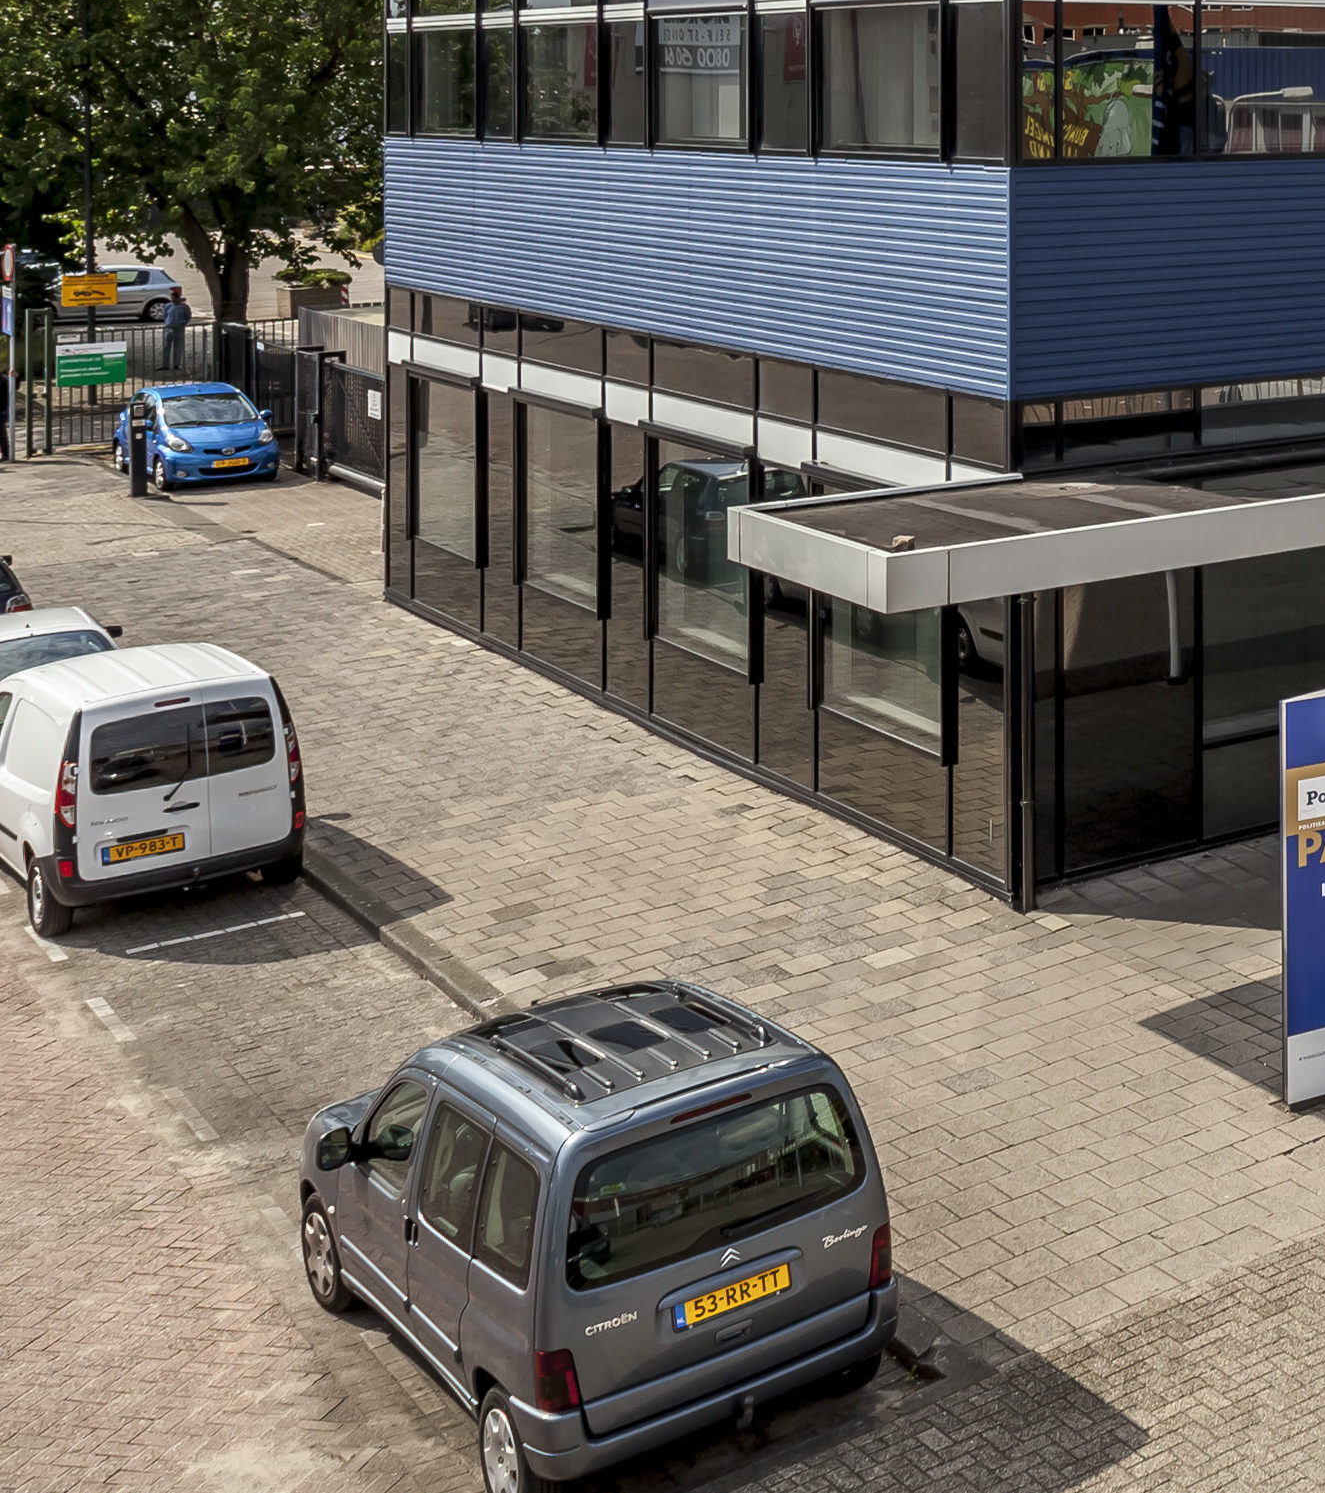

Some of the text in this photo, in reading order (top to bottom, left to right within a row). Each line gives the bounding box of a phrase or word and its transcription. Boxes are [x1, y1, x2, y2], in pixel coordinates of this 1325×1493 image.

[115, 836, 179, 858] VP-983-T
[822, 1225, 869, 1249] Berlingo
[694, 1269, 780, 1318] 53-RR-TT
[584, 1311, 638, 1337] CITROËN
